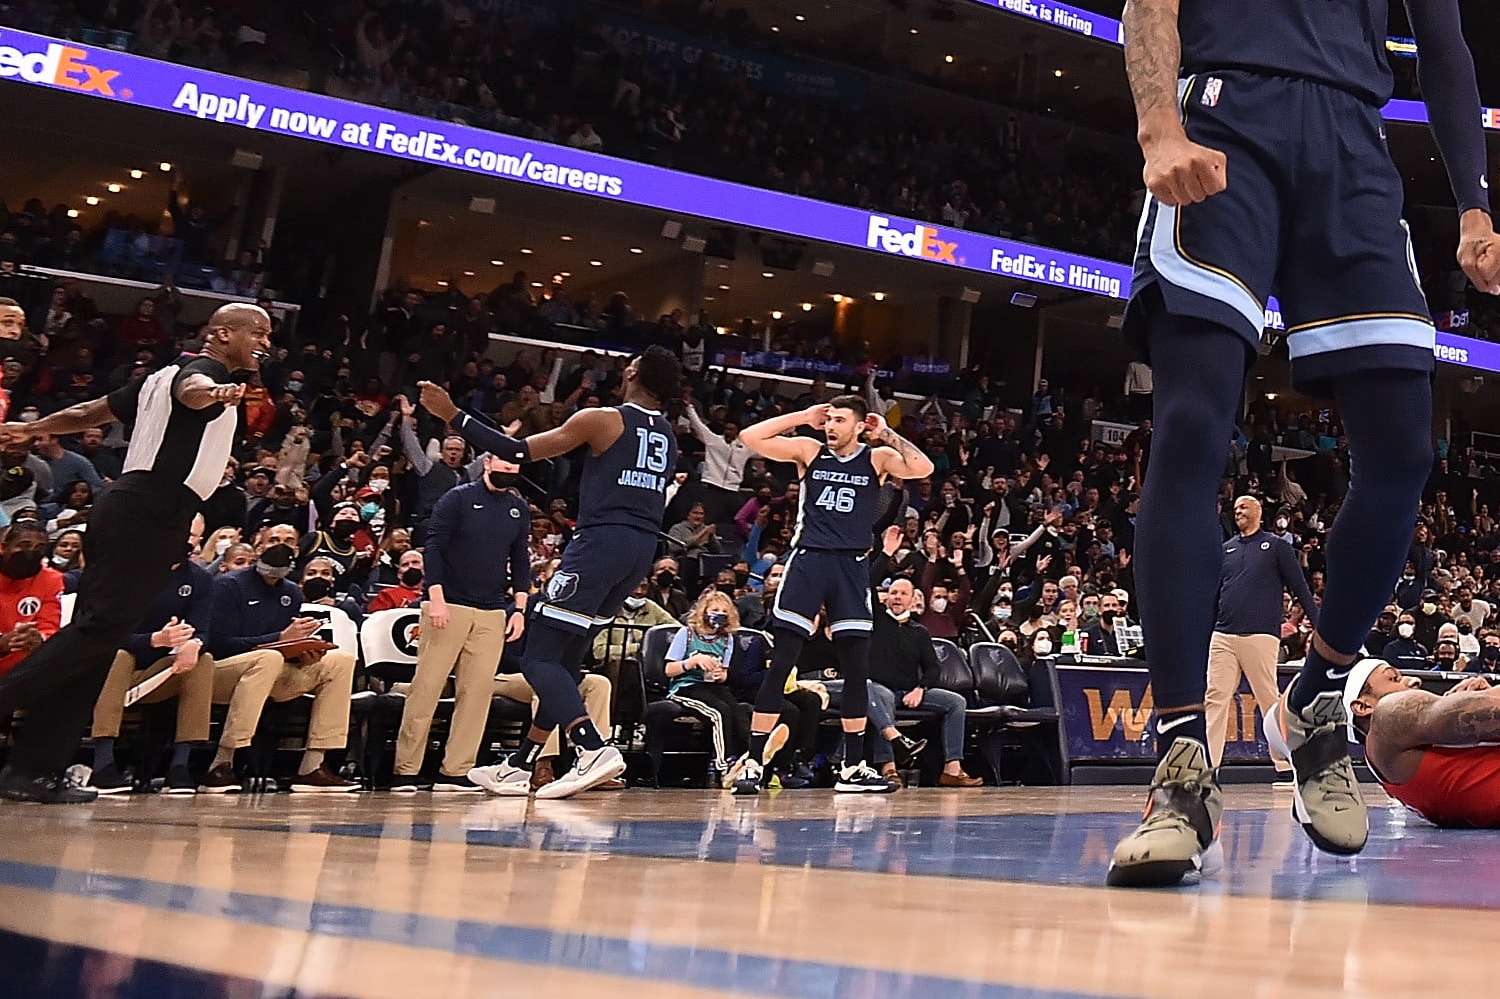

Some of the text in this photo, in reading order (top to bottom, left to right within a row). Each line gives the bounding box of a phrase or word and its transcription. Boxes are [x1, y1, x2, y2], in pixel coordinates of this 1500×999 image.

[1040, 3, 1052, 21] is
[1054, 7, 1092, 36] Hiring
[0, 41, 121, 97] edEx
[172, 82, 623, 196] Apply now at FedEx.com/careers
[867, 215, 958, 264] FedEx
[990, 249, 1121, 298] FedEx is Hiring
[636, 427, 669, 473] 13
[618, 470, 657, 490] JACKSON
[811, 469, 870, 486] GRIZZLIES
[815, 485, 856, 513] 46
